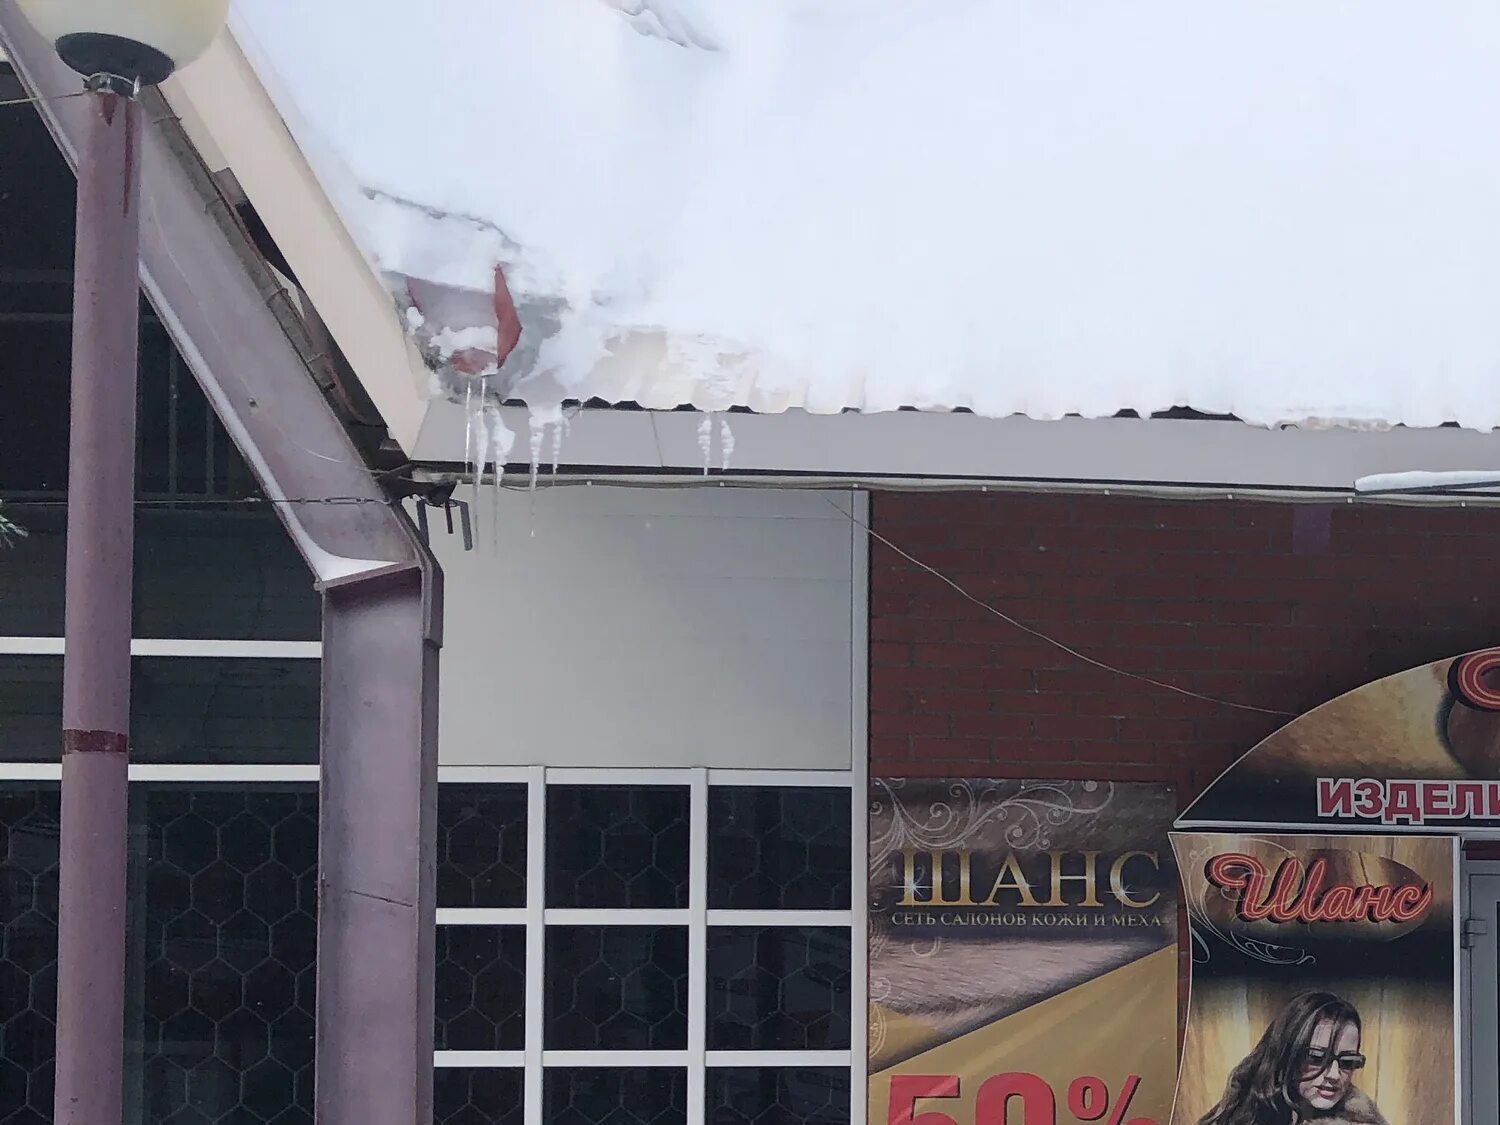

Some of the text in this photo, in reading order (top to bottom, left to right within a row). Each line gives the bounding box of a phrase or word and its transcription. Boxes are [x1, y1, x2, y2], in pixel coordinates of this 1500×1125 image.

[895, 850, 1161, 908] ШАНС
[1206, 852, 1433, 924] Шанс
[891, 912, 1163, 927] СЕТЬ САЛОНОВ КОЖИ И МЕХА
